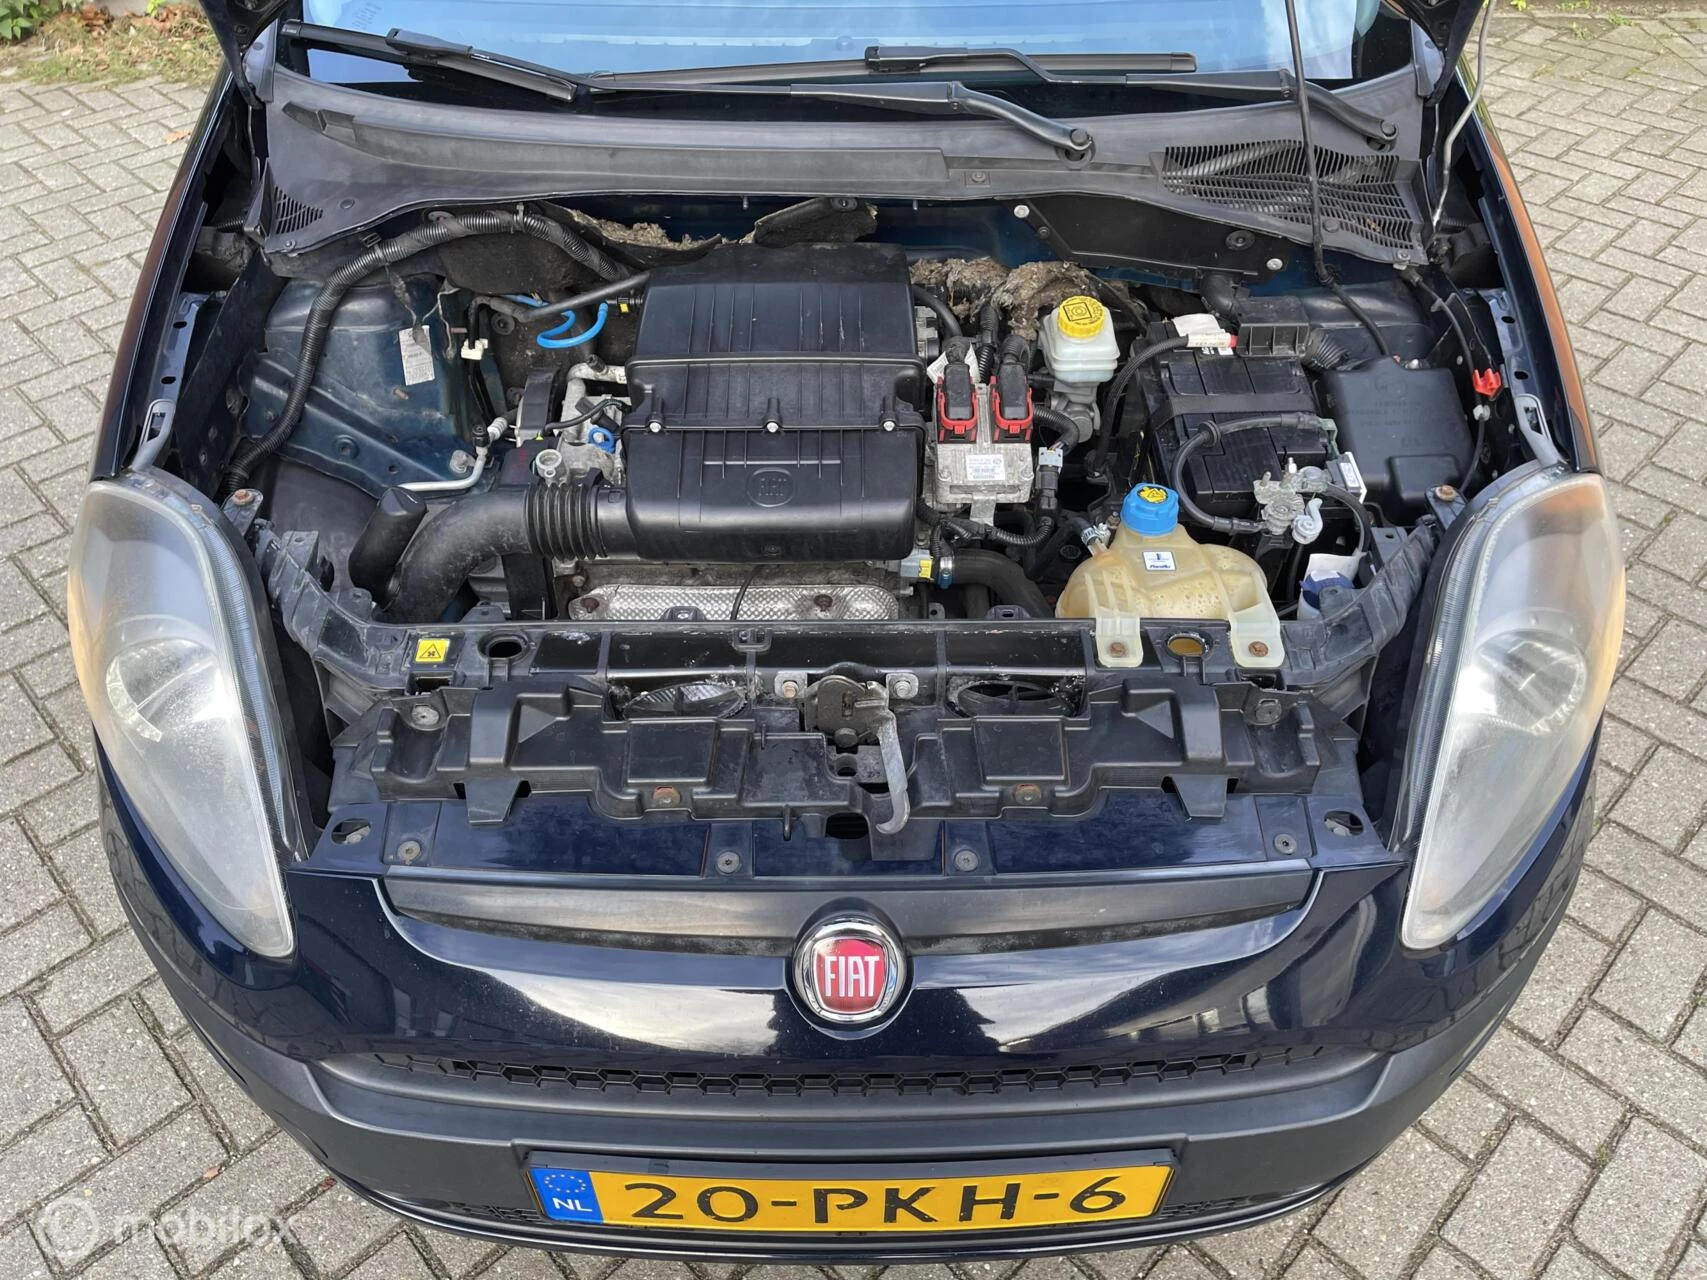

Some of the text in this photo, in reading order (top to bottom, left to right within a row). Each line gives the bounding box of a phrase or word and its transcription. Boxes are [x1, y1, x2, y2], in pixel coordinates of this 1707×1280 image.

[824, 956, 880, 998] FIAT
[552, 1197, 593, 1212] NL
[624, 1175, 1126, 1224] 20-PKH-6
